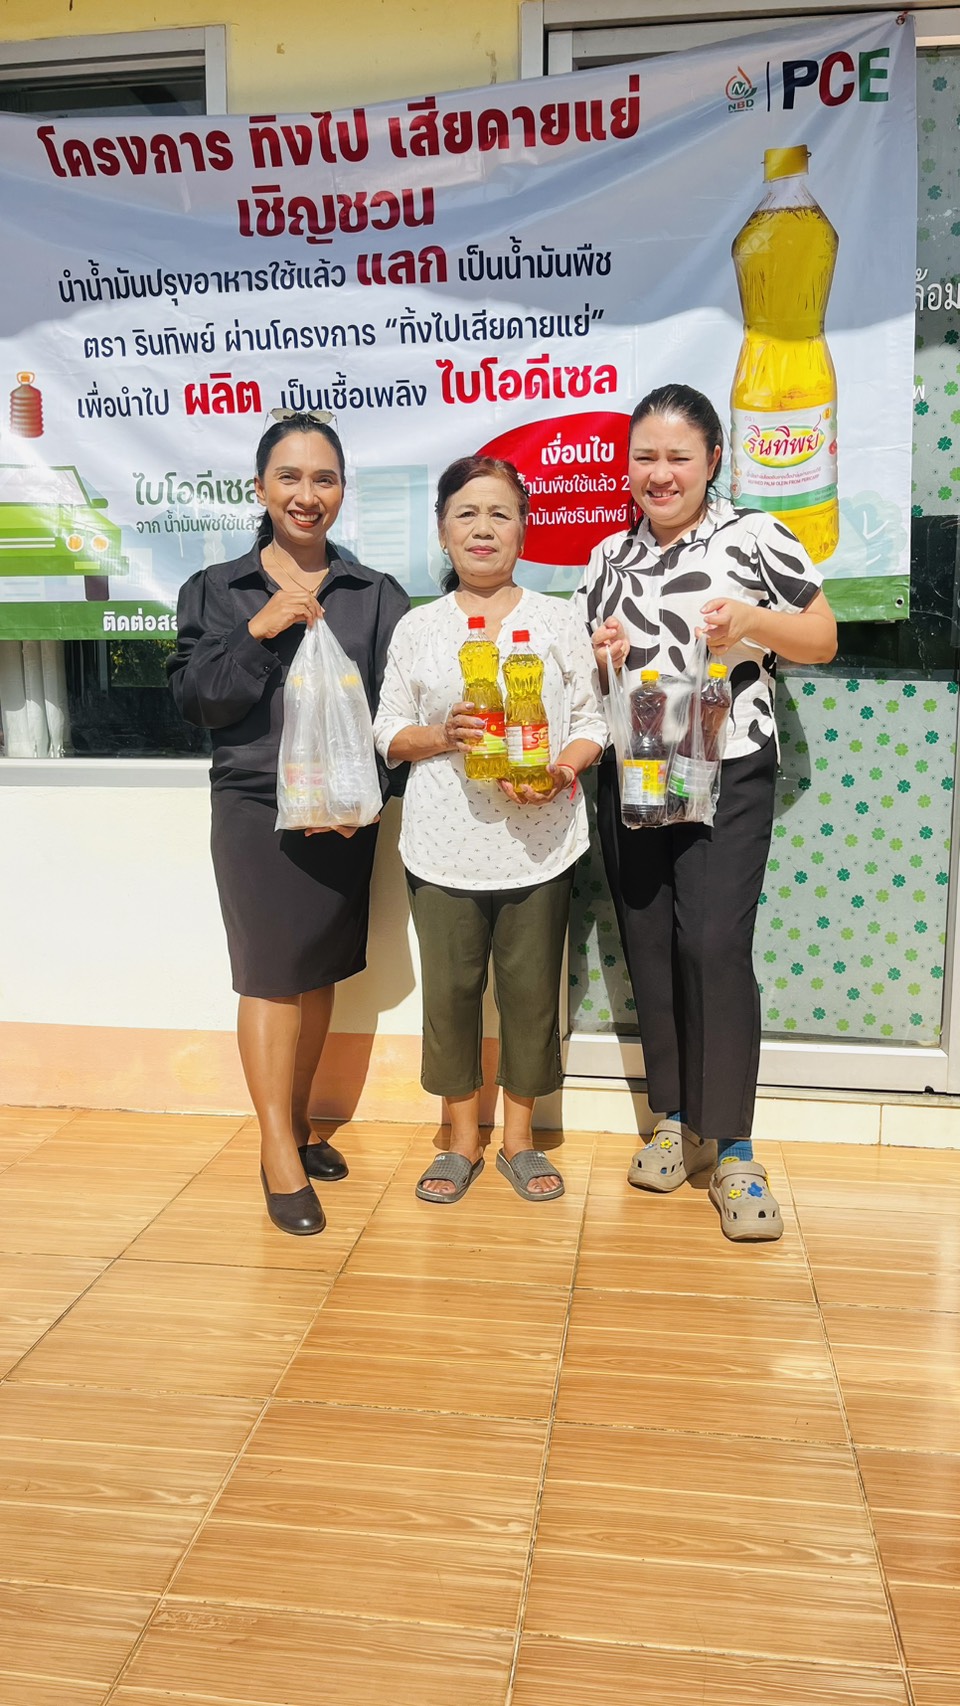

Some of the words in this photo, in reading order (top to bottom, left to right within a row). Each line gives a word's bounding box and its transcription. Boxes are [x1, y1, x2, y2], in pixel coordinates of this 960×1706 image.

[783, 47, 890, 110] PCE
[728, 99, 754, 111] NBD
[37, 126, 234, 178] โครงการ
[249, 108, 369, 169] ทิงไป
[388, 74, 640, 159] เสียดายแย่
[237, 184, 434, 244] เชิญชวน
[58, 259, 346, 306] นำน้ำมันปรุงอาหารใช้แล้ว
[356, 245, 448, 286] แลก
[458, 236, 612, 282] เป็นน้ำมันพืช
[84, 336, 126, 358] ตรา
[132, 323, 215, 356] รินทิพย์
[225, 319, 376, 351] ผ่านโครงการ
[77, 381, 170, 418] เพื่อนำไป
[184, 372, 262, 416] ผลิต
[280, 372, 427, 411] เป็นเชื้อเพลิง
[436, 353, 618, 404] ไบโอดีเซล
[541, 432, 615, 465] เงื่อนไข
[748, 414, 821, 456] รินทิพย์
[517, 473, 617, 494] ้ำมันพืชใช้แล้ว
[621, 475, 631, 491] 2
[136, 519, 160, 533] จาก
[526, 504, 627, 526] ำมันพืชรินทิพย์
